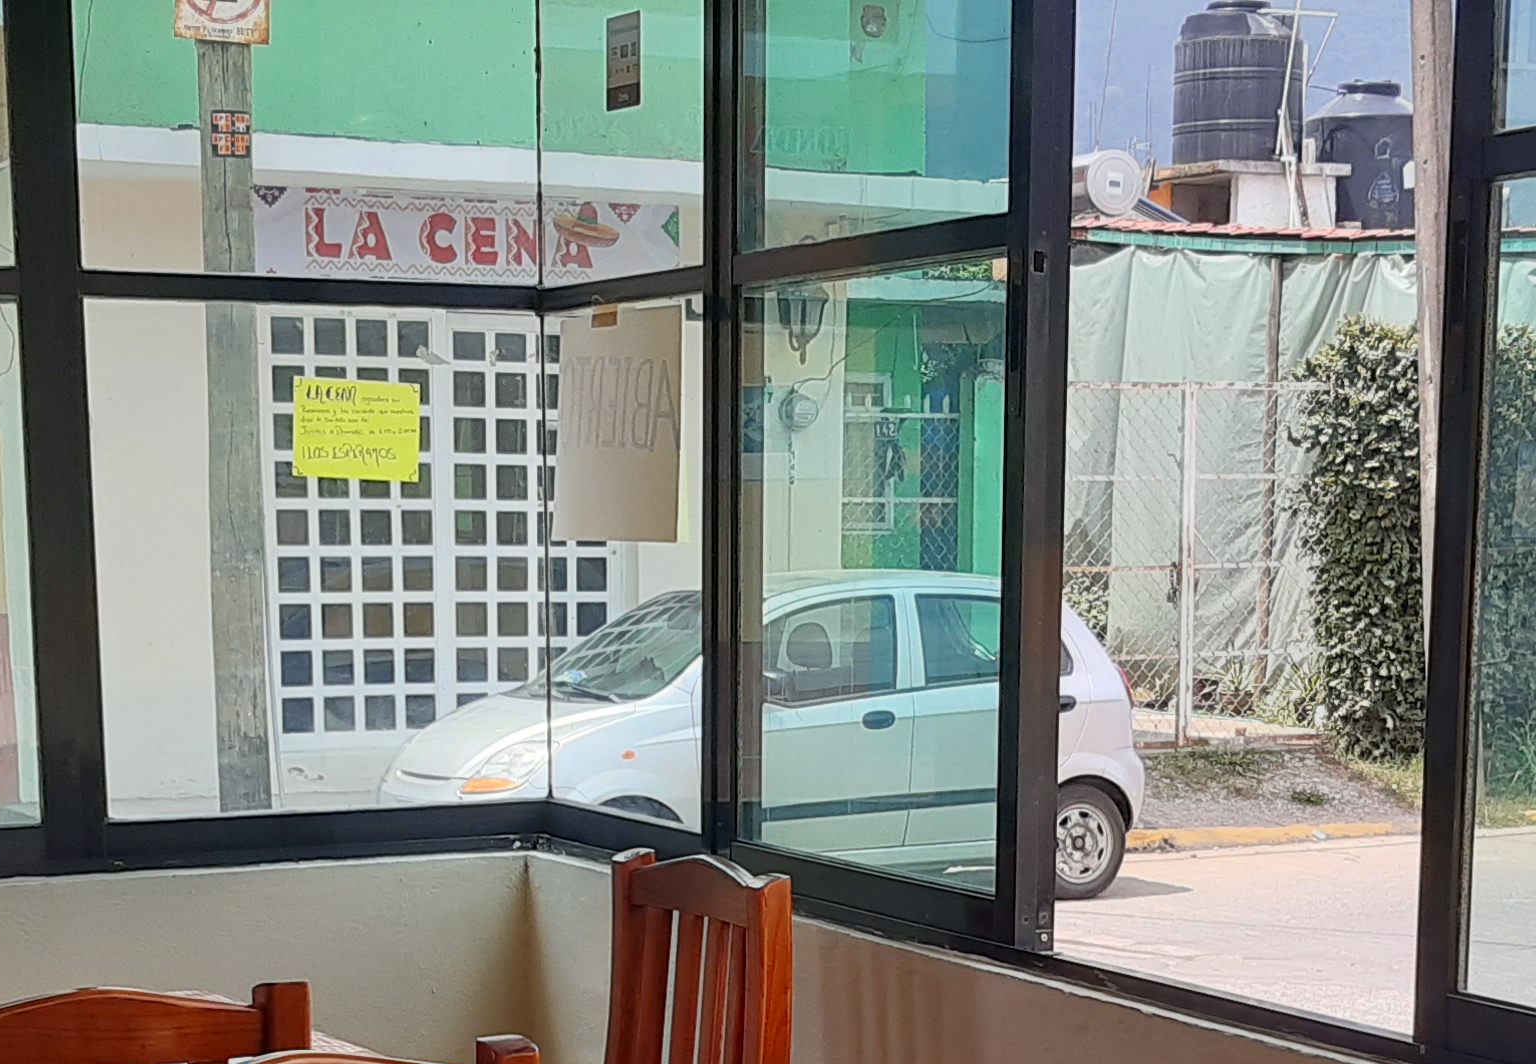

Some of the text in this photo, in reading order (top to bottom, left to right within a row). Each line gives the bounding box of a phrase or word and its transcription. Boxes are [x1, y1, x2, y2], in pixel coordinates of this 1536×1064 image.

[304, 206, 594, 270] LA CENA
[875, 423, 898, 437] 142
